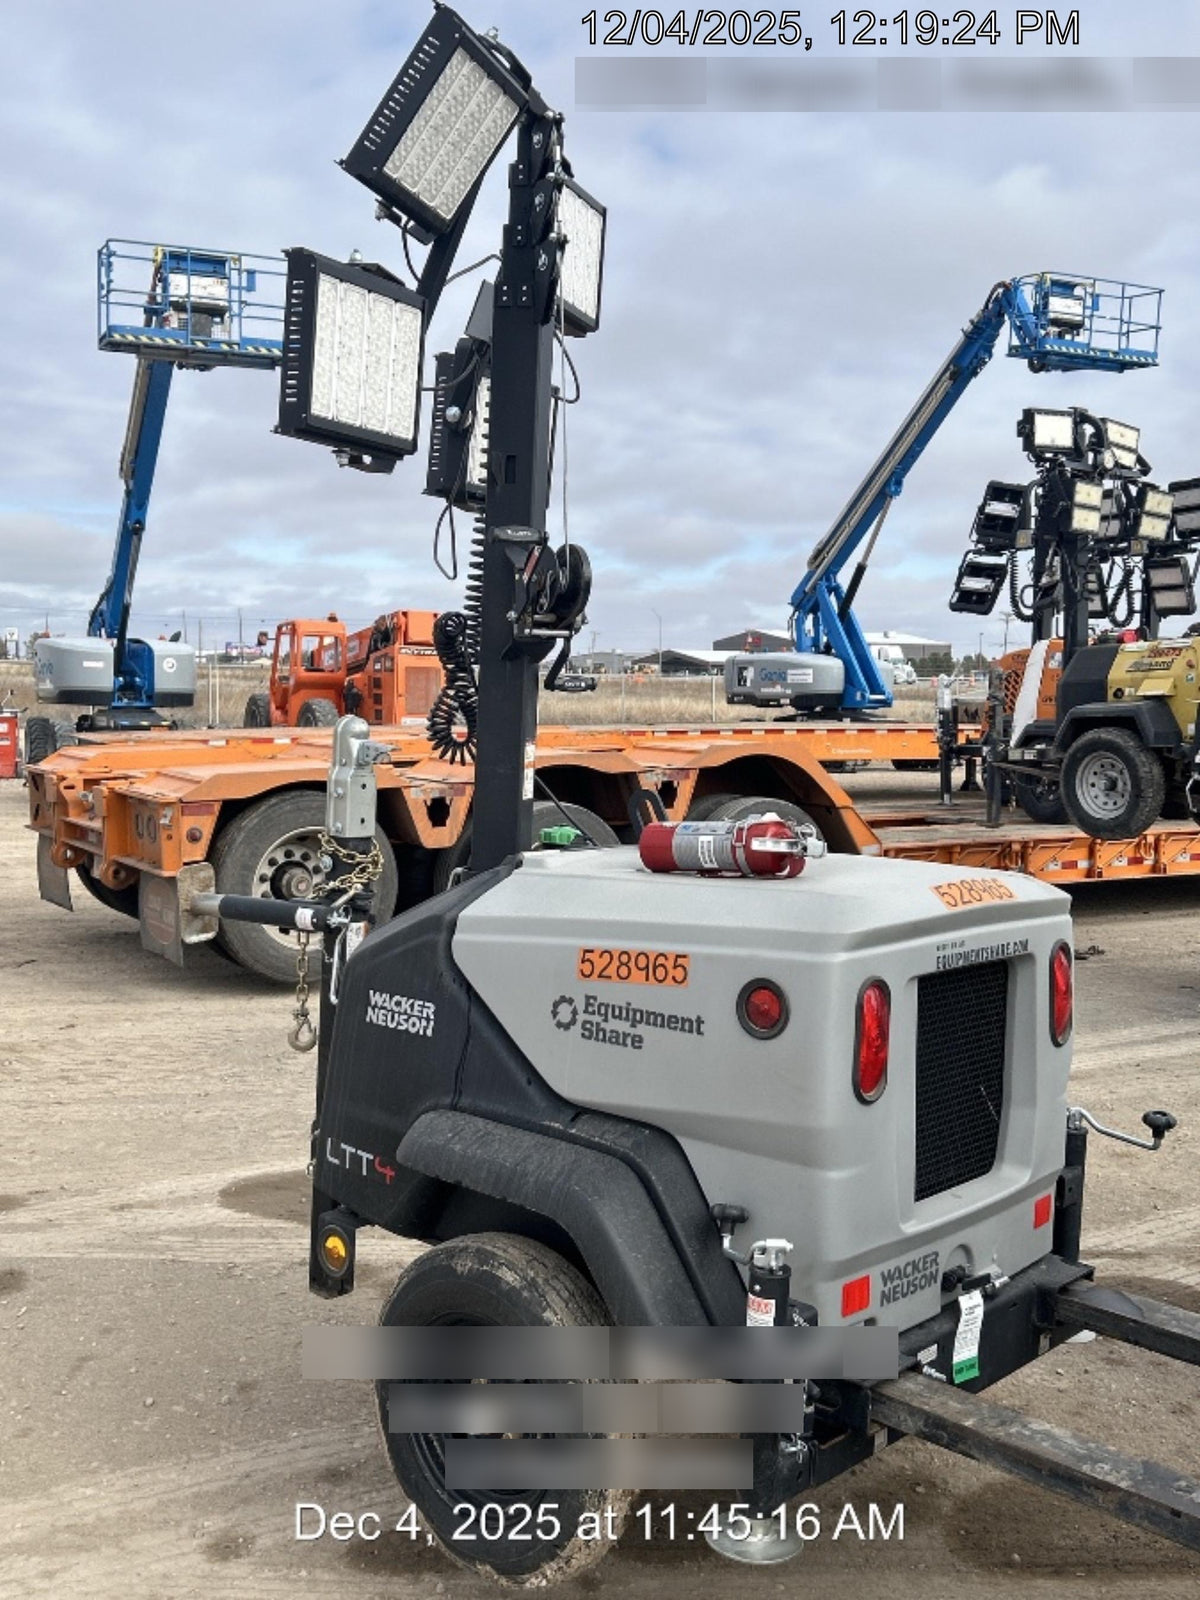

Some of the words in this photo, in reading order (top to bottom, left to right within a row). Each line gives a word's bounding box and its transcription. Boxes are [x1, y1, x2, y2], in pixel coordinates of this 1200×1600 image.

[579, 949, 689, 984] 528965
[365, 1006, 435, 1037] NEUSON
[368, 989, 436, 1019] WACKER
[583, 994, 705, 1036] Equipment
[580, 1020, 644, 1050] Share
[326, 1137, 396, 1185] LTT4
[880, 1250, 939, 1288] WACKER
[880, 1267, 939, 1307] NEUSON
